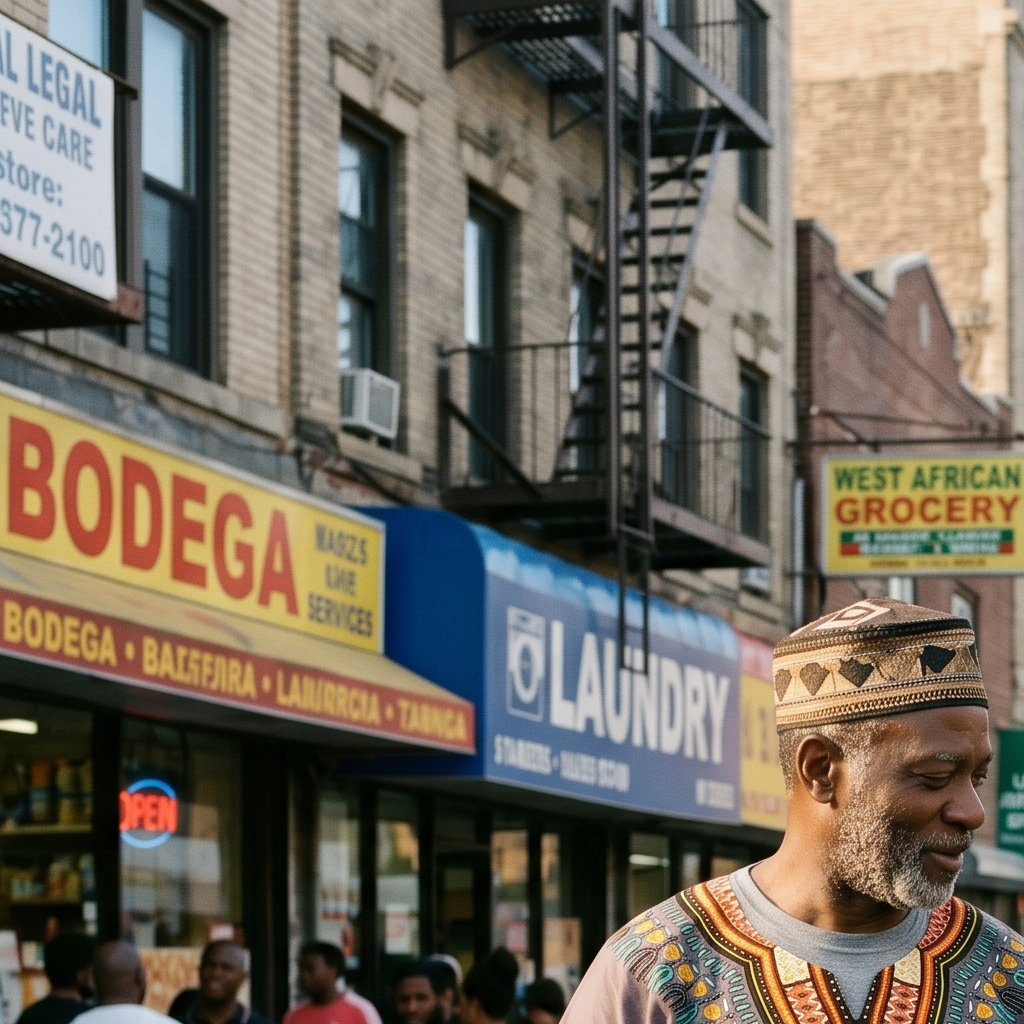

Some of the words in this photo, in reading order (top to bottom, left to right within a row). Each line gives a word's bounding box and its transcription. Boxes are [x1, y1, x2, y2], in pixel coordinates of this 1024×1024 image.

[0, 29, 18, 84] L
[27, 43, 102, 129] LEGAL
[42, 114, 94, 172] CARE
[833, 466, 902, 492] WEST
[910, 464, 1021, 491] AFRICAN
[834, 495, 1020, 525] GROCERY
[8, 415, 299, 616] BODEGA
[4, 600, 118, 668] BODEGA
[550, 619, 730, 765] LAUNDRY
